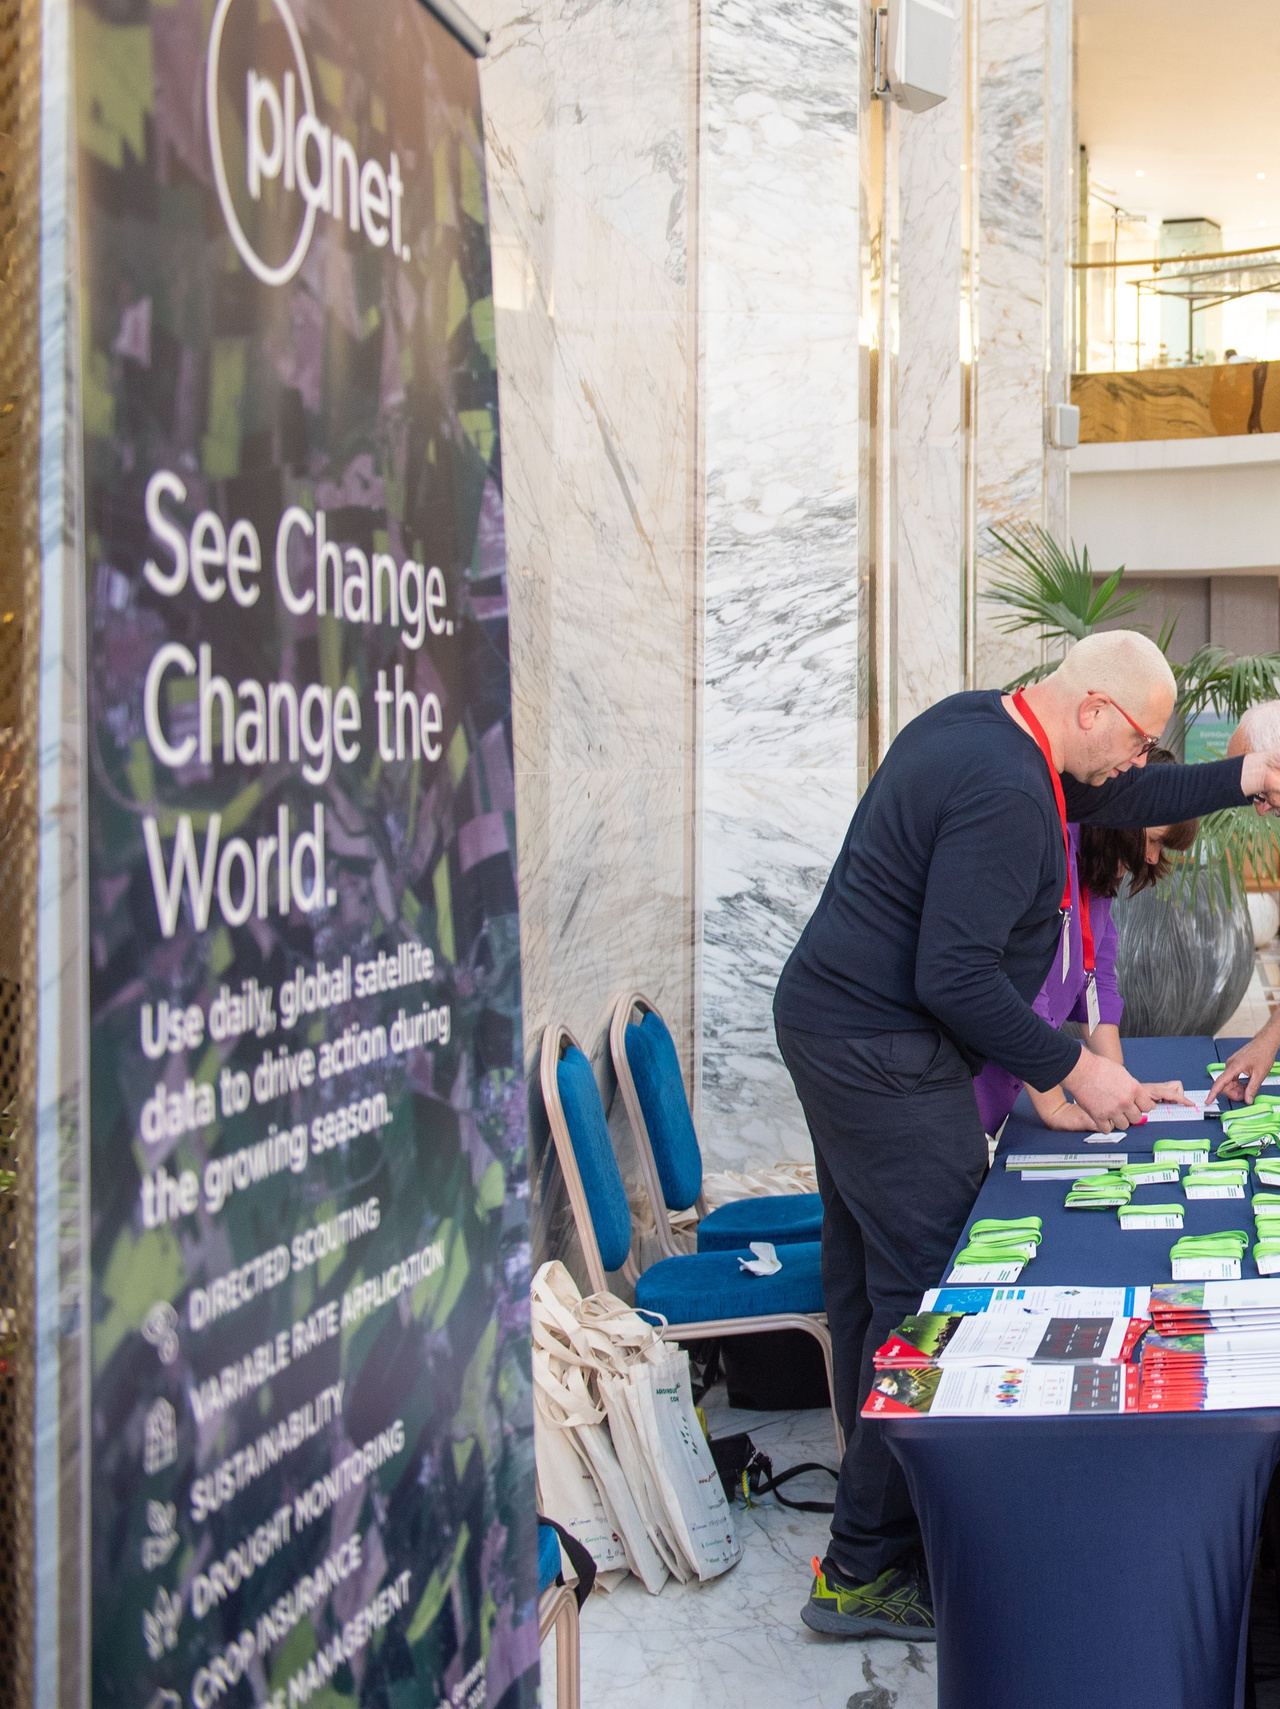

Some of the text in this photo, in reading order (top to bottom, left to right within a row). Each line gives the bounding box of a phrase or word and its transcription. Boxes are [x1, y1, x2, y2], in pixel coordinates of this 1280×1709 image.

[143, 470, 454, 649] See Change.
[144, 642, 443, 785] Change the
[142, 802, 337, 937] World.
[141, 942, 434, 1059] Use daily, global satellite
[141, 1001, 450, 1143] data to drive action during
[141, 1092, 393, 1228] the growing season.
[189, 1197, 380, 1330] DIRECTED SCOUTING
[292, 1299, 339, 1359] RATE
[190, 1378, 345, 1522] SUSTAINABILITY
[192, 1419, 405, 1618] DROUGHT MONITORING
